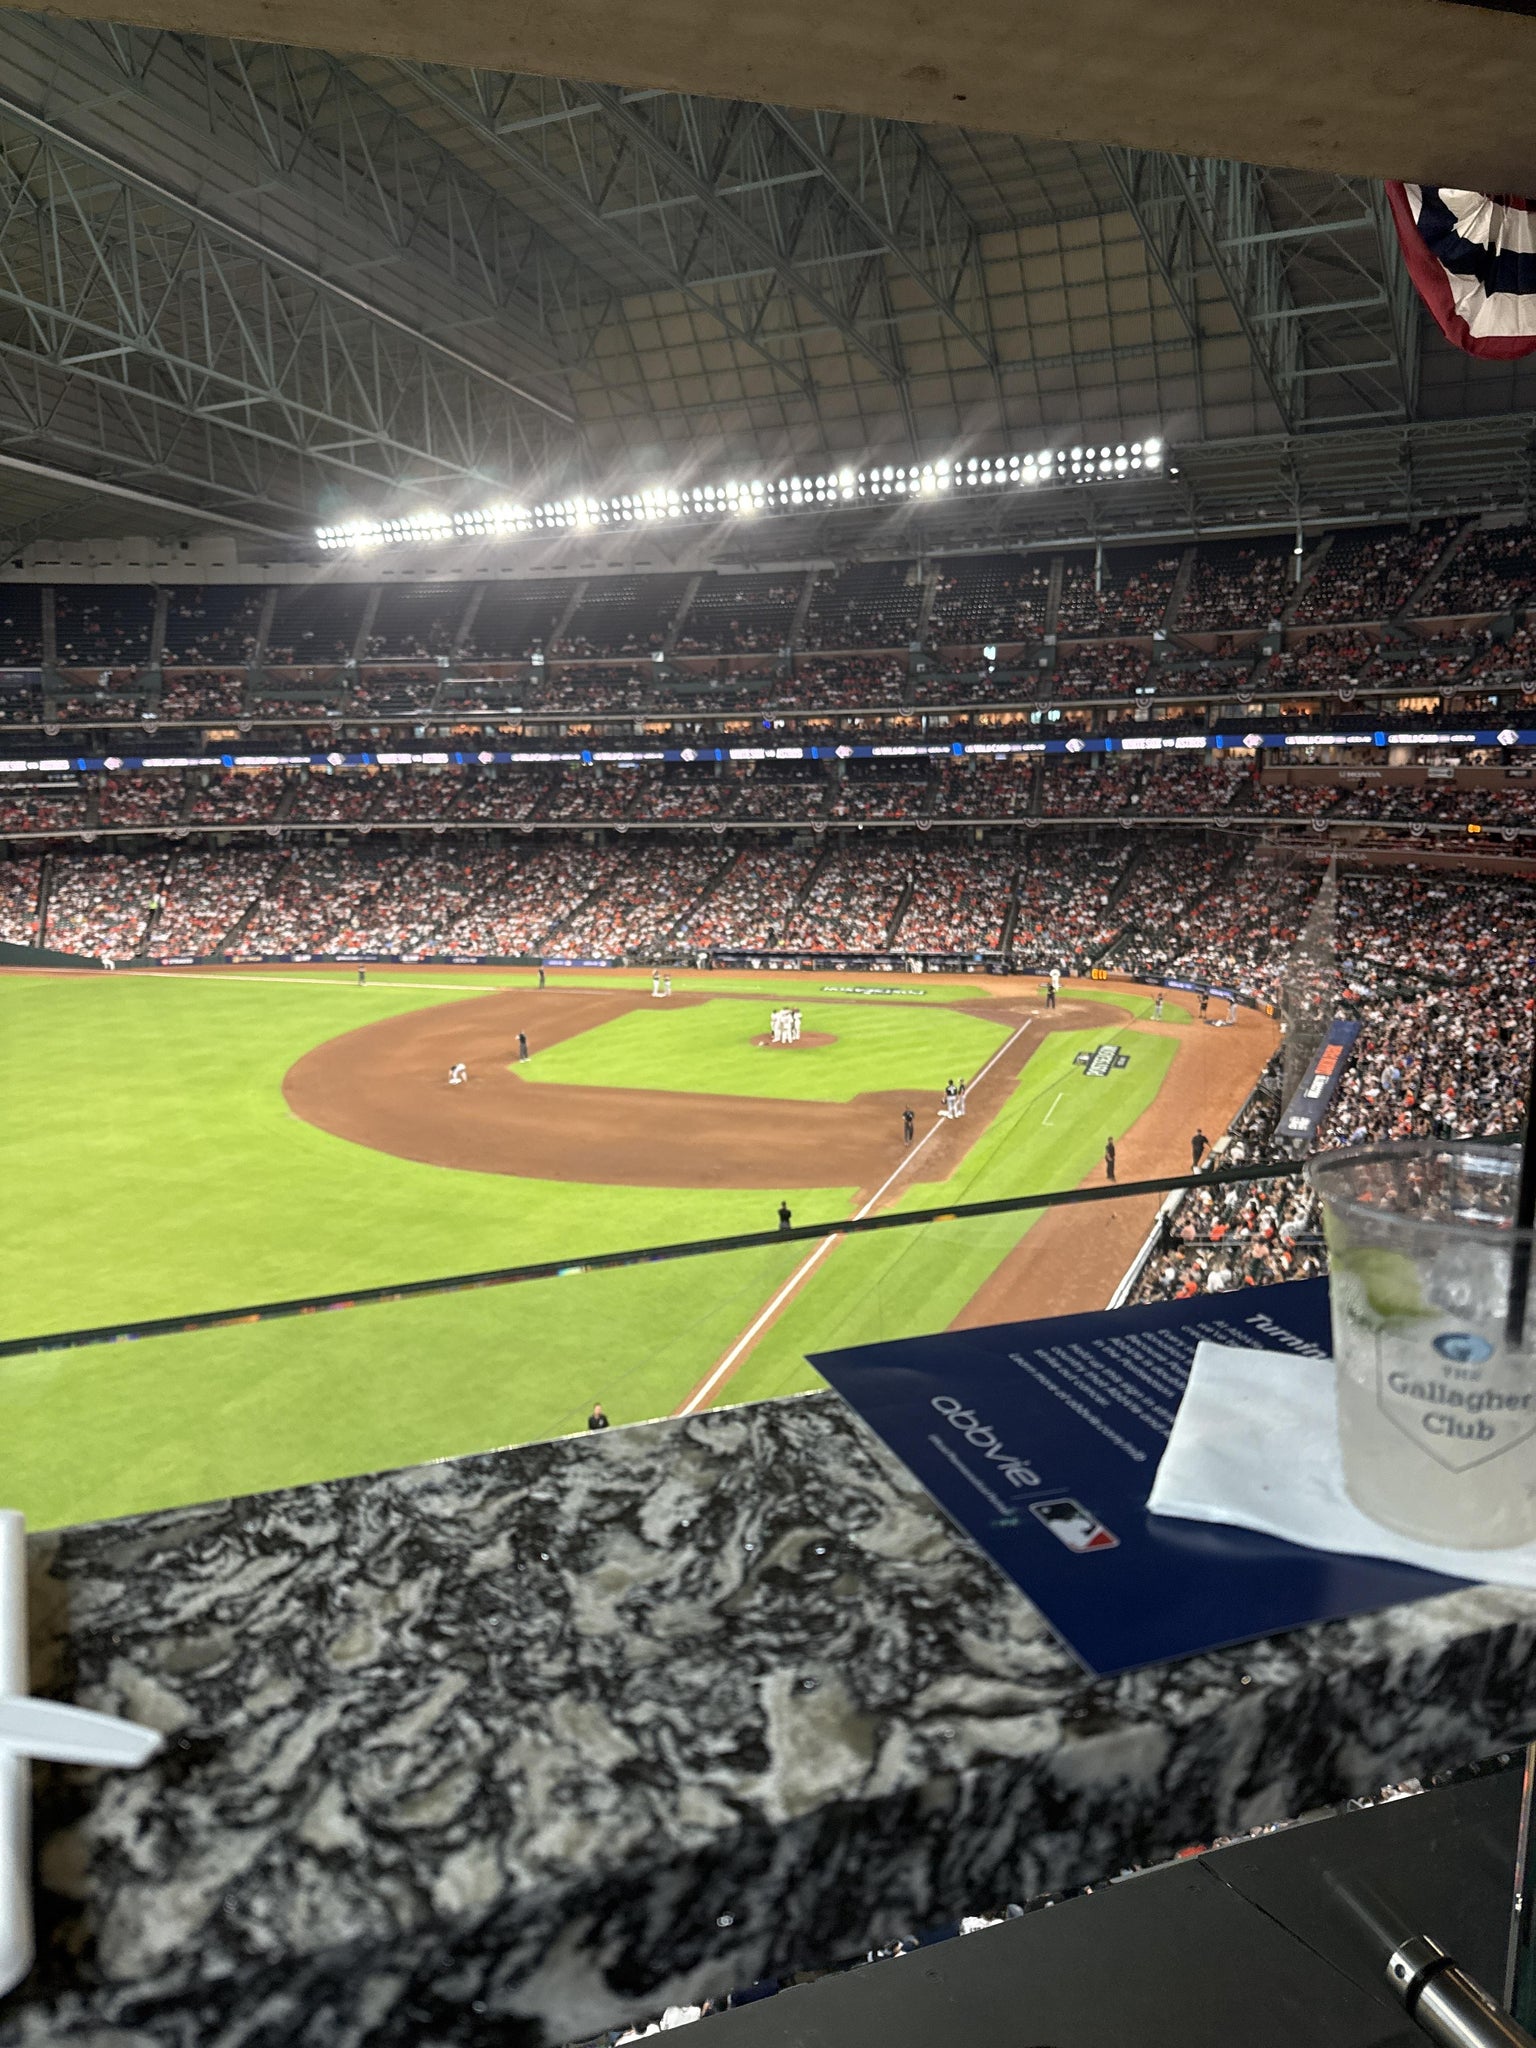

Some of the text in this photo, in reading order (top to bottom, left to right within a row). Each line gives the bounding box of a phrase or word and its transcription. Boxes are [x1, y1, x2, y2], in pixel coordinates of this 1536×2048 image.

[1245, 1312, 1330, 1360] Turnin
[1387, 1371, 1532, 1414] Gallagher
[931, 1395, 1042, 1488] abbvie
[1422, 1410, 1496, 1441] Club
